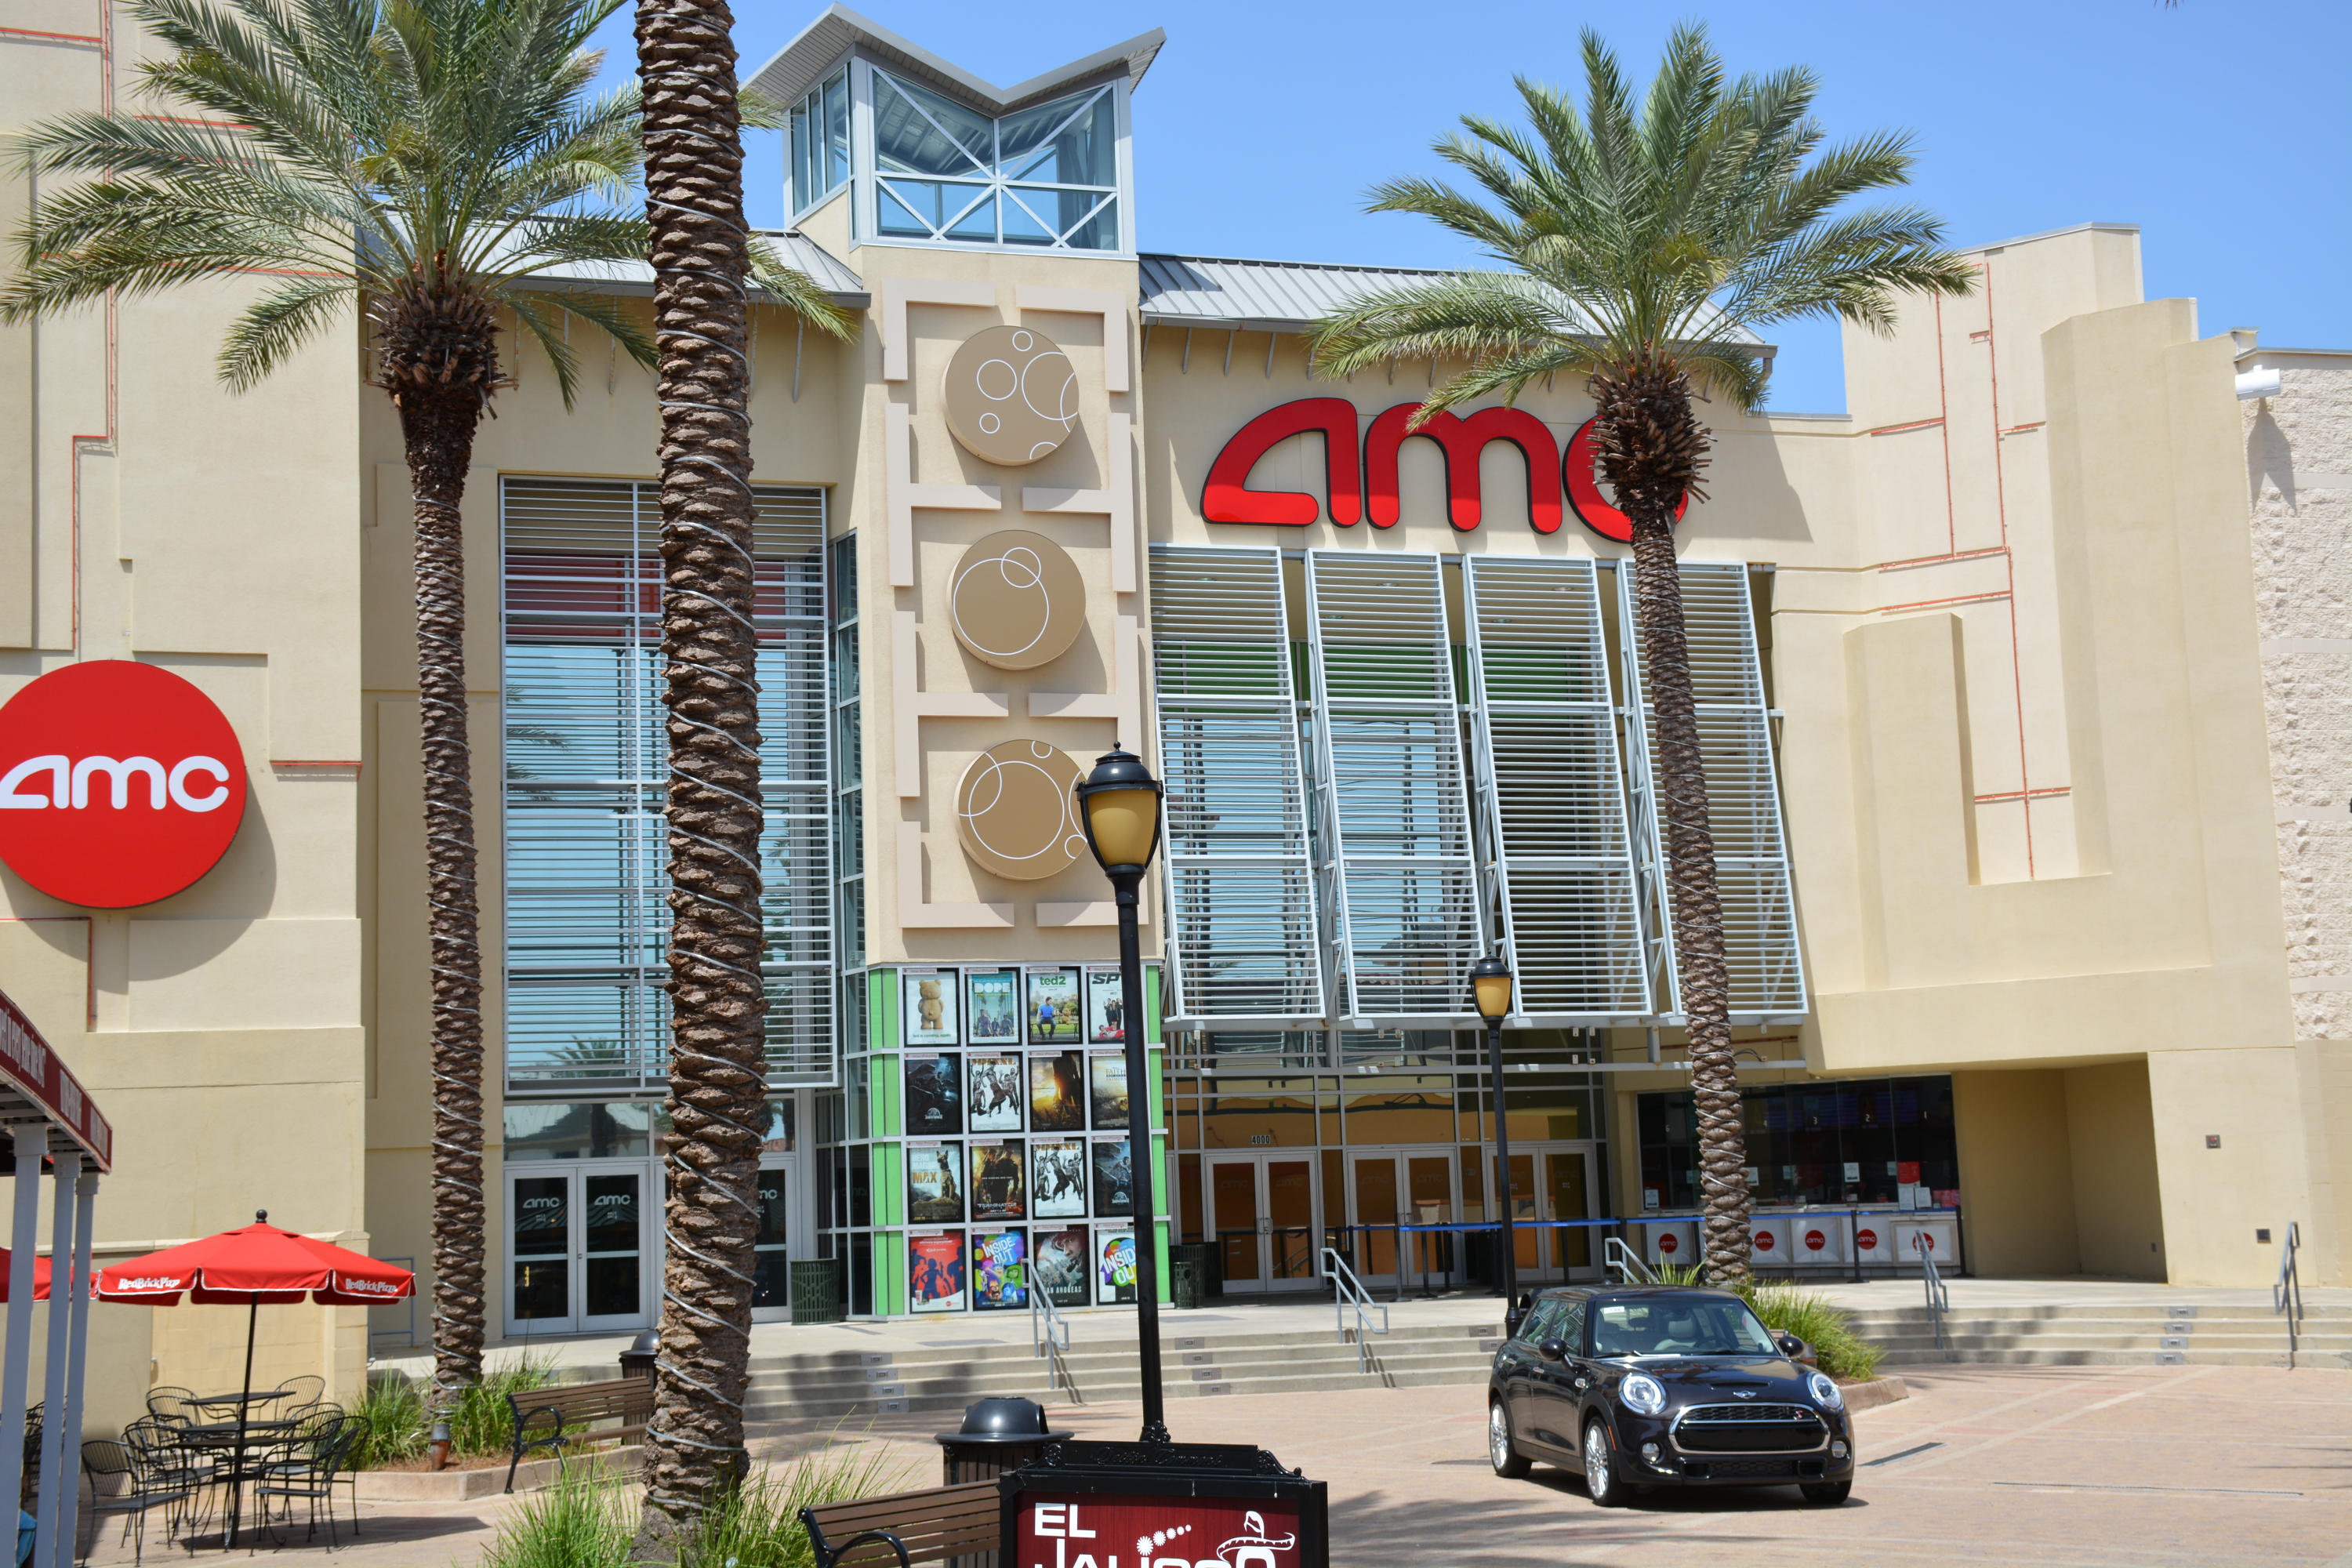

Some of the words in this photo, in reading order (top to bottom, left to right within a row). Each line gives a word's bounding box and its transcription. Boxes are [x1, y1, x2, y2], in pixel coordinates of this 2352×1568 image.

[0, 754, 230, 813] amc
[1091, 973, 1120, 985] SP
[974, 982, 1011, 993] DOPE
[1251, 1135, 1271, 1144] 4000
[912, 1171, 937, 1184] MAX
[758, 1189, 778, 1200] mc
[982, 1236, 1015, 1258] INSIDE
[993, 1248, 1014, 1264] OUT
[1102, 1246, 1136, 1274] INSID
[1115, 1265, 1136, 1284] OU
[1034, 1502, 1097, 1538] EL
